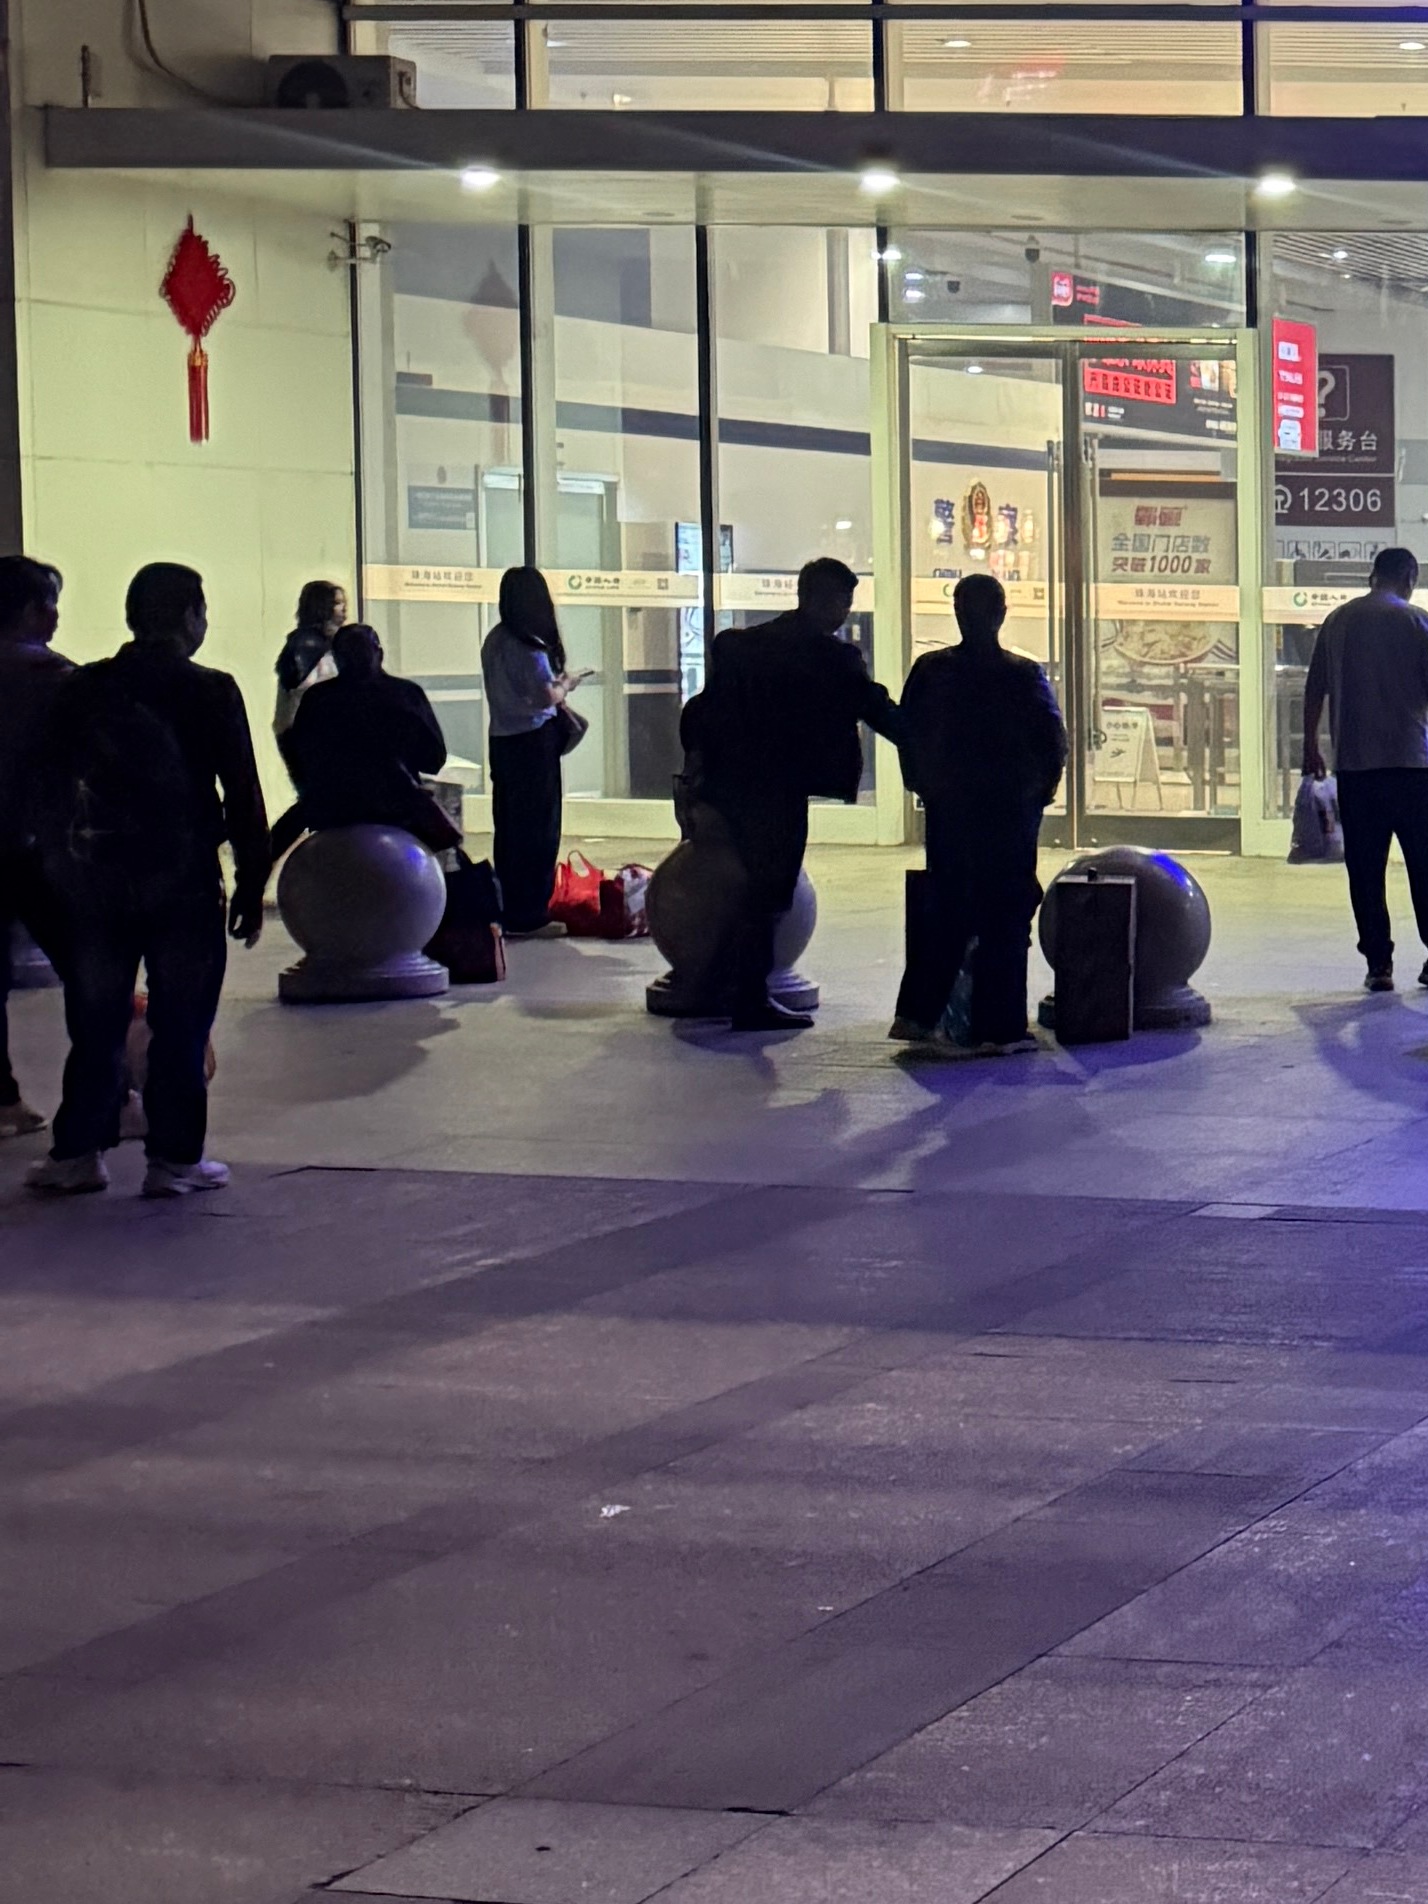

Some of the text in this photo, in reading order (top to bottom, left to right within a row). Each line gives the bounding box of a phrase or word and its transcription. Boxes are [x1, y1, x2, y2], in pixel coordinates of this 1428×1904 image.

[1299, 487, 1382, 512] 12306
[1111, 533, 1211, 555] 全国门店数
[1111, 555, 1211, 575] 突破1000家
